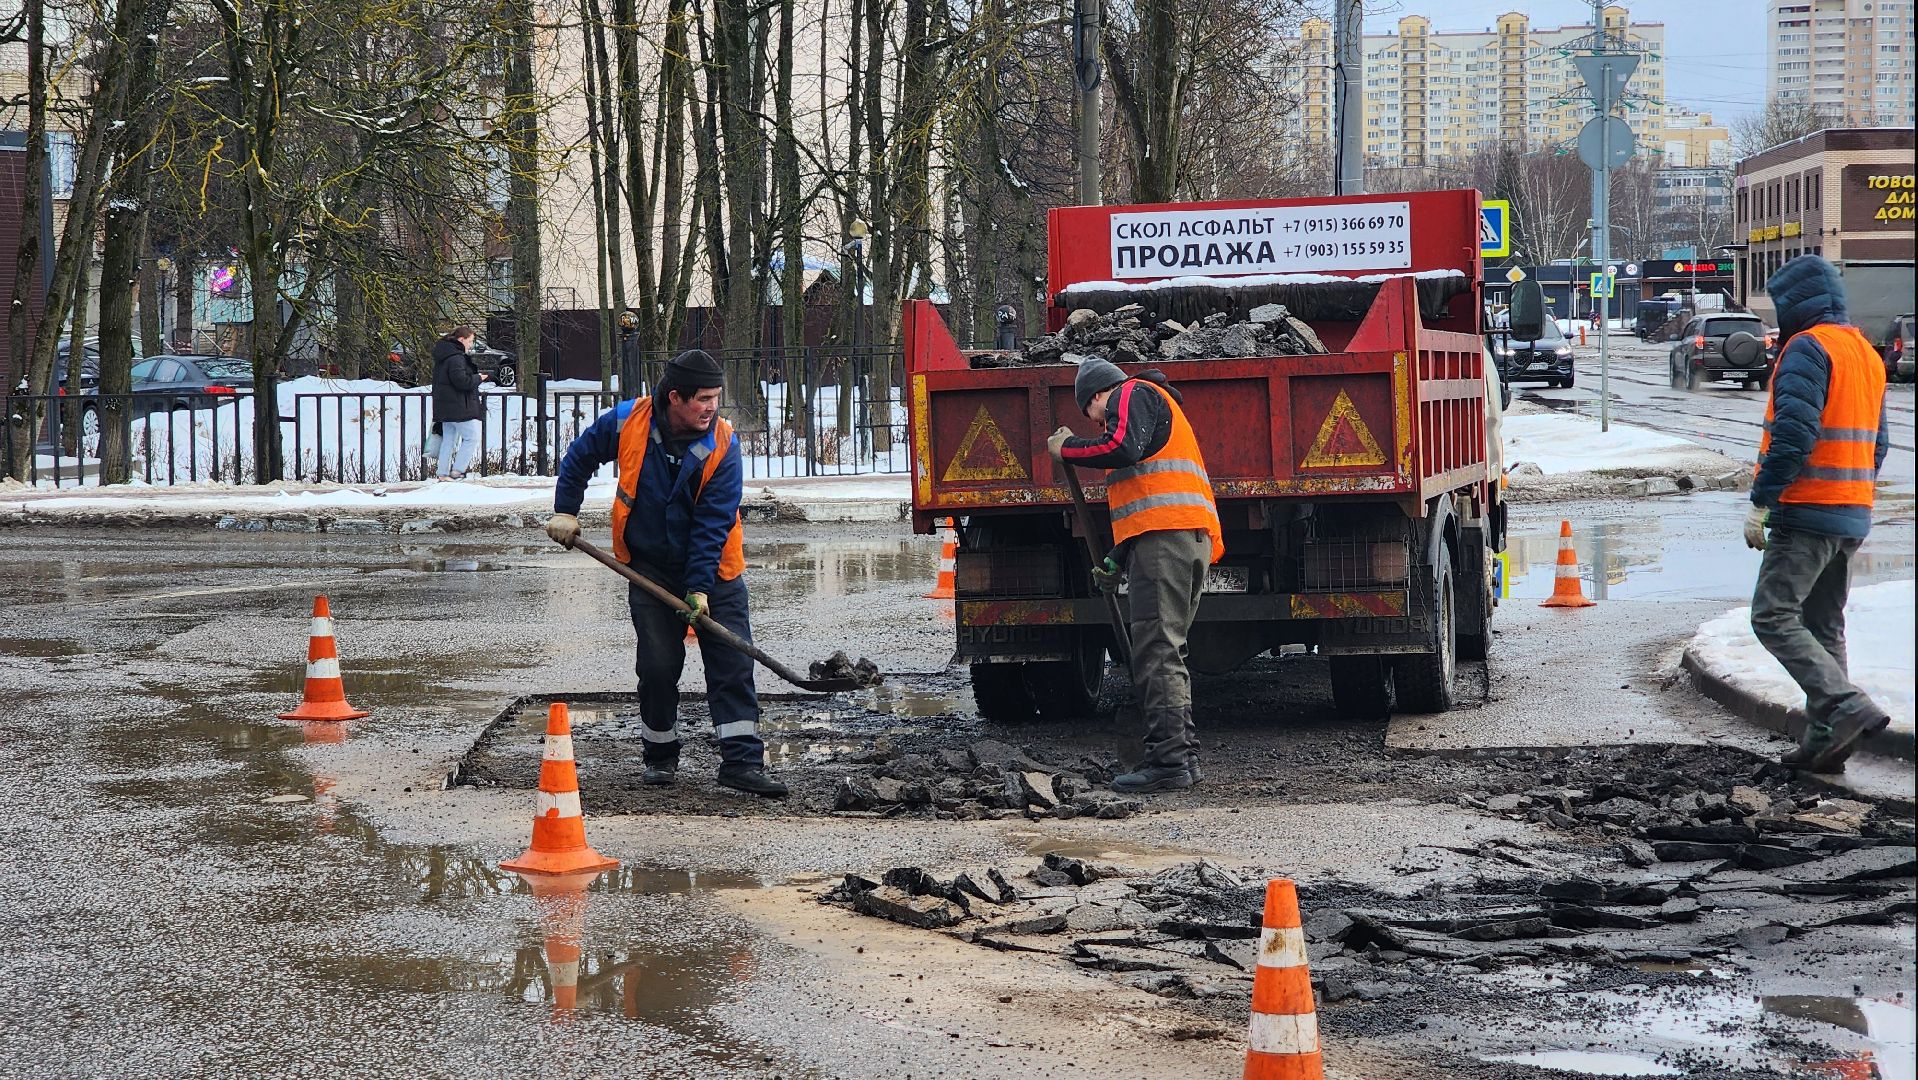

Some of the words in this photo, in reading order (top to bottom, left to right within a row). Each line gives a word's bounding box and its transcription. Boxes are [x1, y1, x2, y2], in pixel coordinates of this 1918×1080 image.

[1116, 222, 1171, 239] СКОЛ
[1178, 217, 1275, 237] АСФАЛЬТ
[1282, 220, 1301, 233] +7
[1304, 217, 1338, 234] (915)
[1341, 217, 1366, 231] 366
[1368, 216, 1385, 230] 69
[1388, 215, 1404, 229] 70
[1117, 240, 1276, 269] ПРОДАЖА
[1283, 244, 1301, 258] +7
[1305, 242, 1339, 258] (903)
[1342, 242, 1366, 255] 155
[1369, 241, 1385, 255] 59
[1388, 240, 1404, 254] 35
